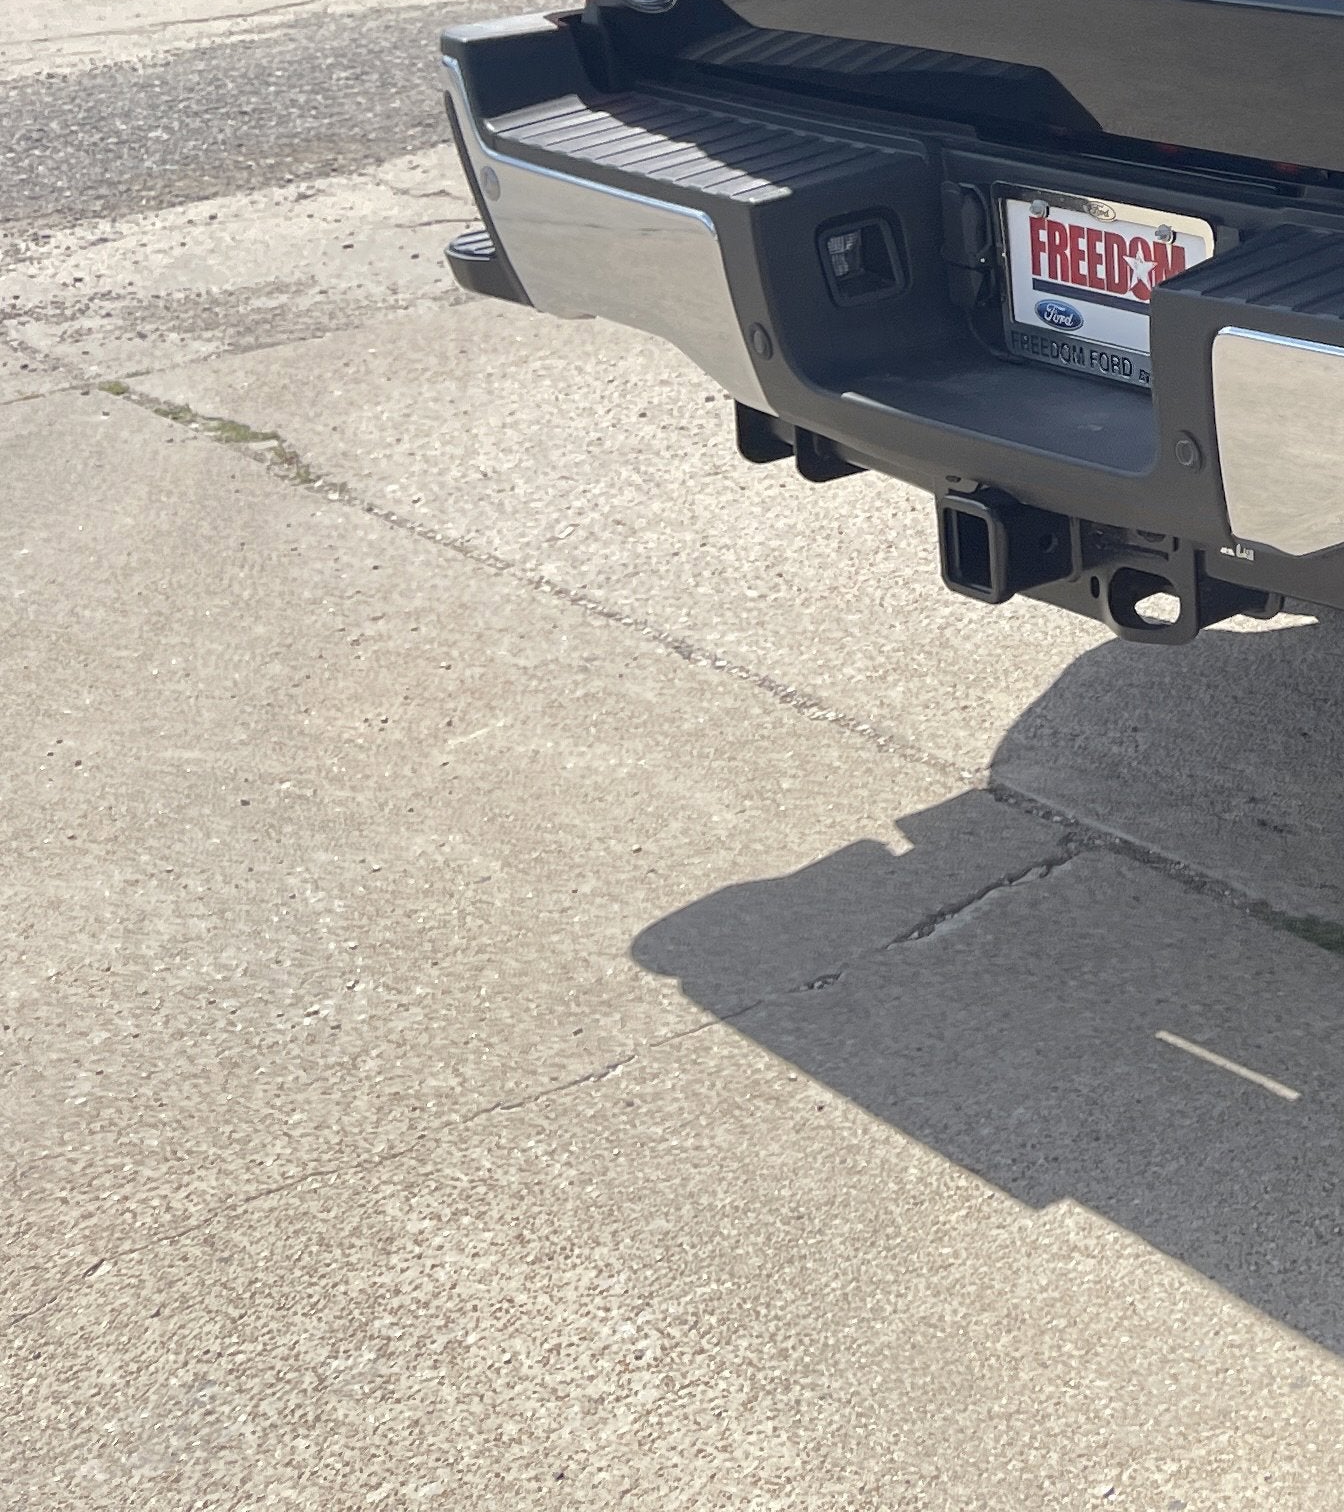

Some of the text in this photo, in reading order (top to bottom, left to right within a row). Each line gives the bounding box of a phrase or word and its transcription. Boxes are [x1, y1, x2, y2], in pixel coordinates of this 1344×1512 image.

[1043, 302, 1074, 327] Ford
[1011, 330, 1086, 367] FREEDOM
[1089, 349, 1134, 378] FORD
